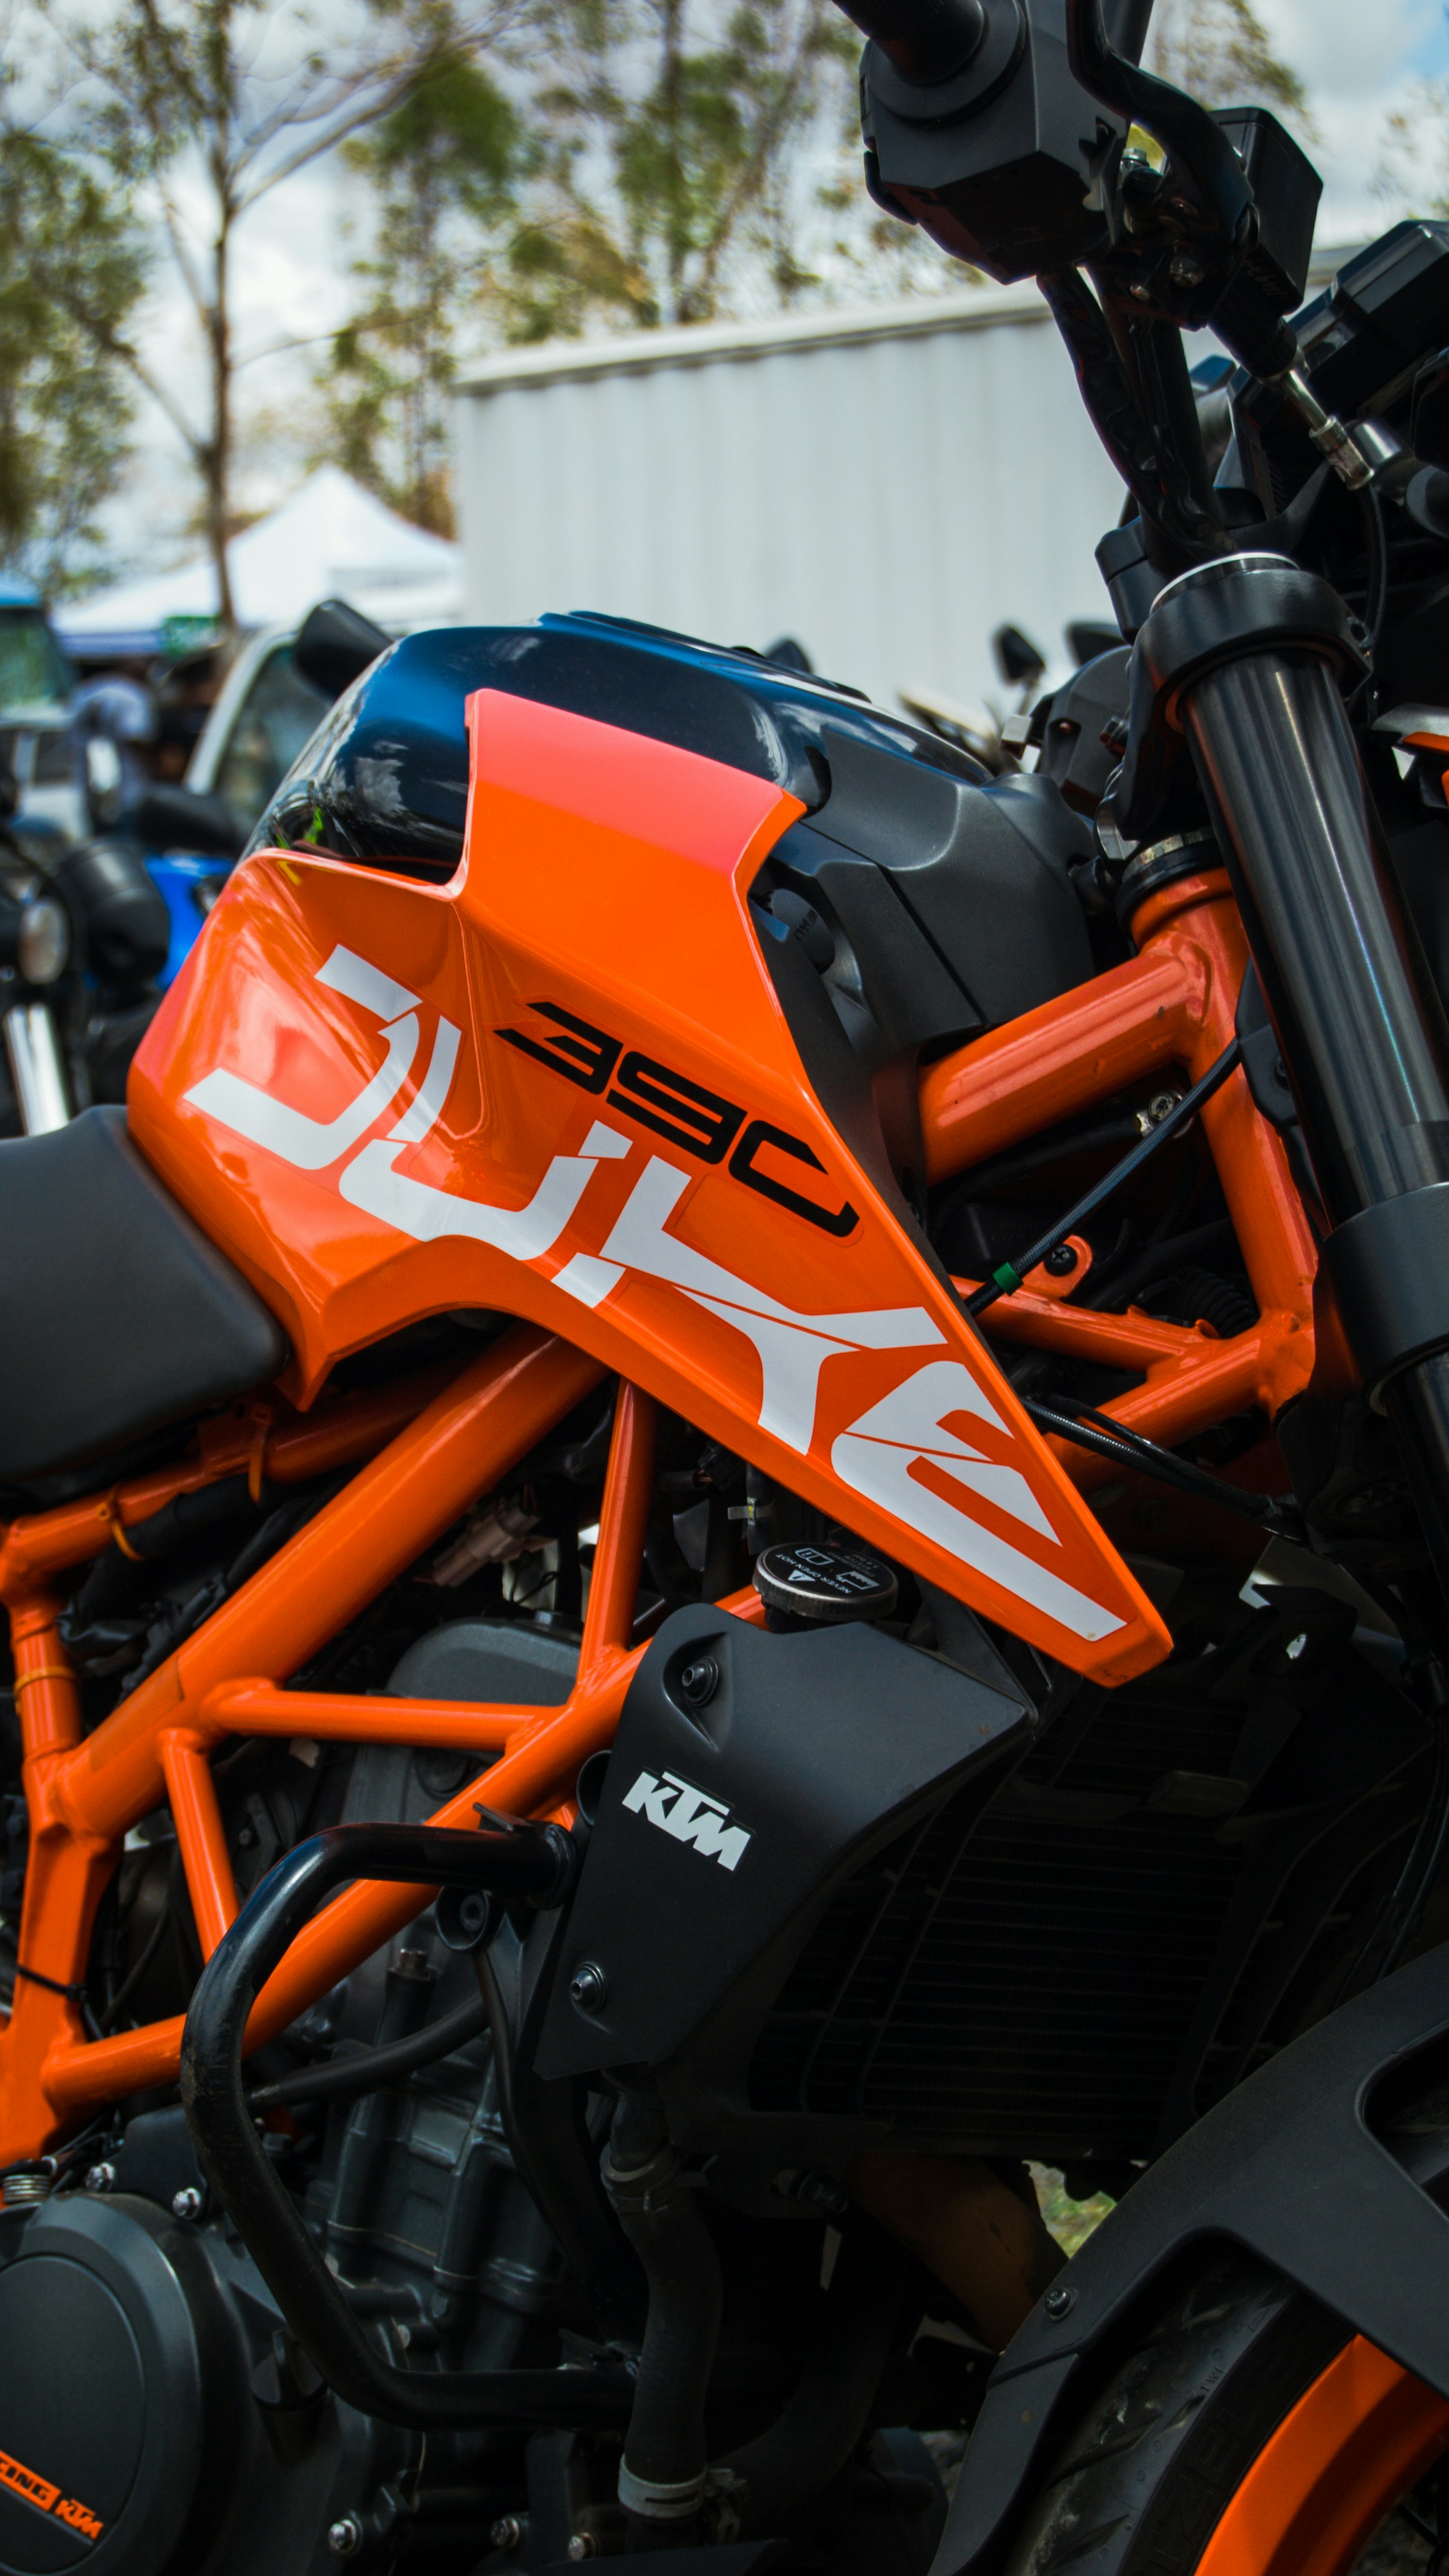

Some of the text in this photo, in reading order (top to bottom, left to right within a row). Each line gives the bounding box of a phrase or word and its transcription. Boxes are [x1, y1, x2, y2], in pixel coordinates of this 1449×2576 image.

[493, 1001, 860, 1238] 390
[183, 943, 1128, 1641] DUKE
[775, 1553, 852, 1593] NEVER OPEN HOT
[621, 1771, 751, 1872] KTM
[55, 2499, 104, 2539] KTM
